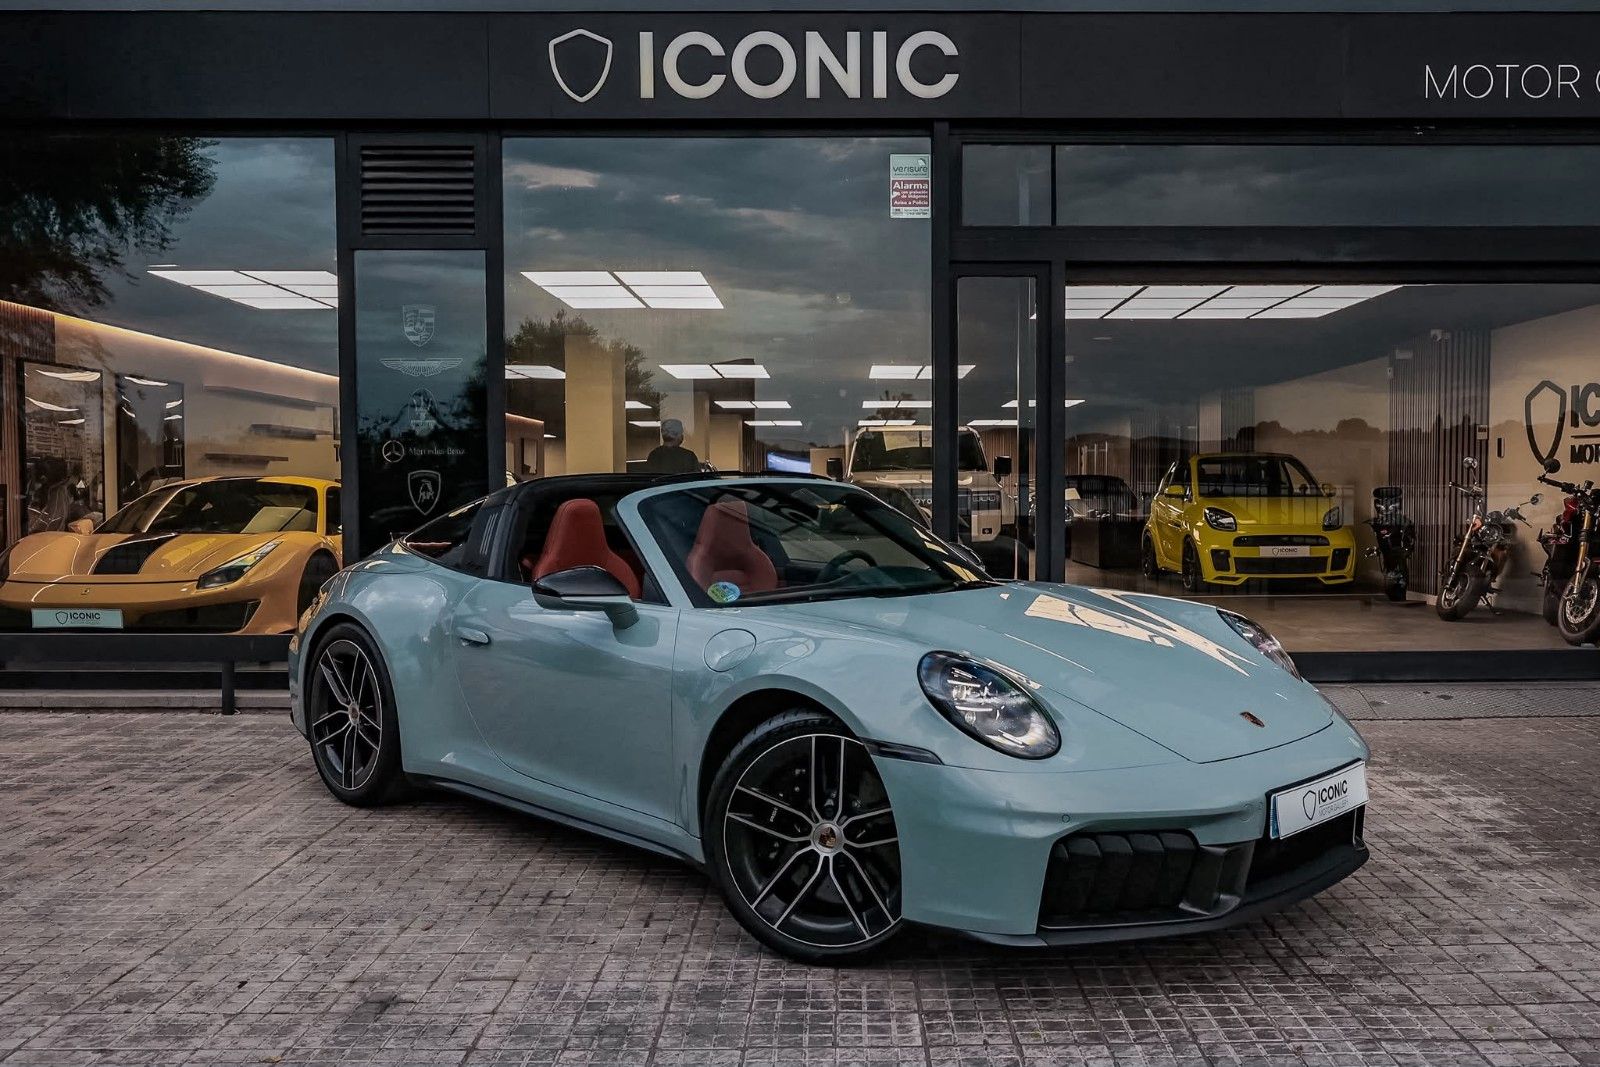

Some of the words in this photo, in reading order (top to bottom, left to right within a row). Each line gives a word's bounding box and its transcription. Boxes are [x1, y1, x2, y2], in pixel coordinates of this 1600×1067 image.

[639, 31, 960, 99] ICONIC
[1425, 64, 1580, 98] MOTOR
[893, 181, 928, 190] Alarma
[1318, 780, 1348, 804] ICONIC
